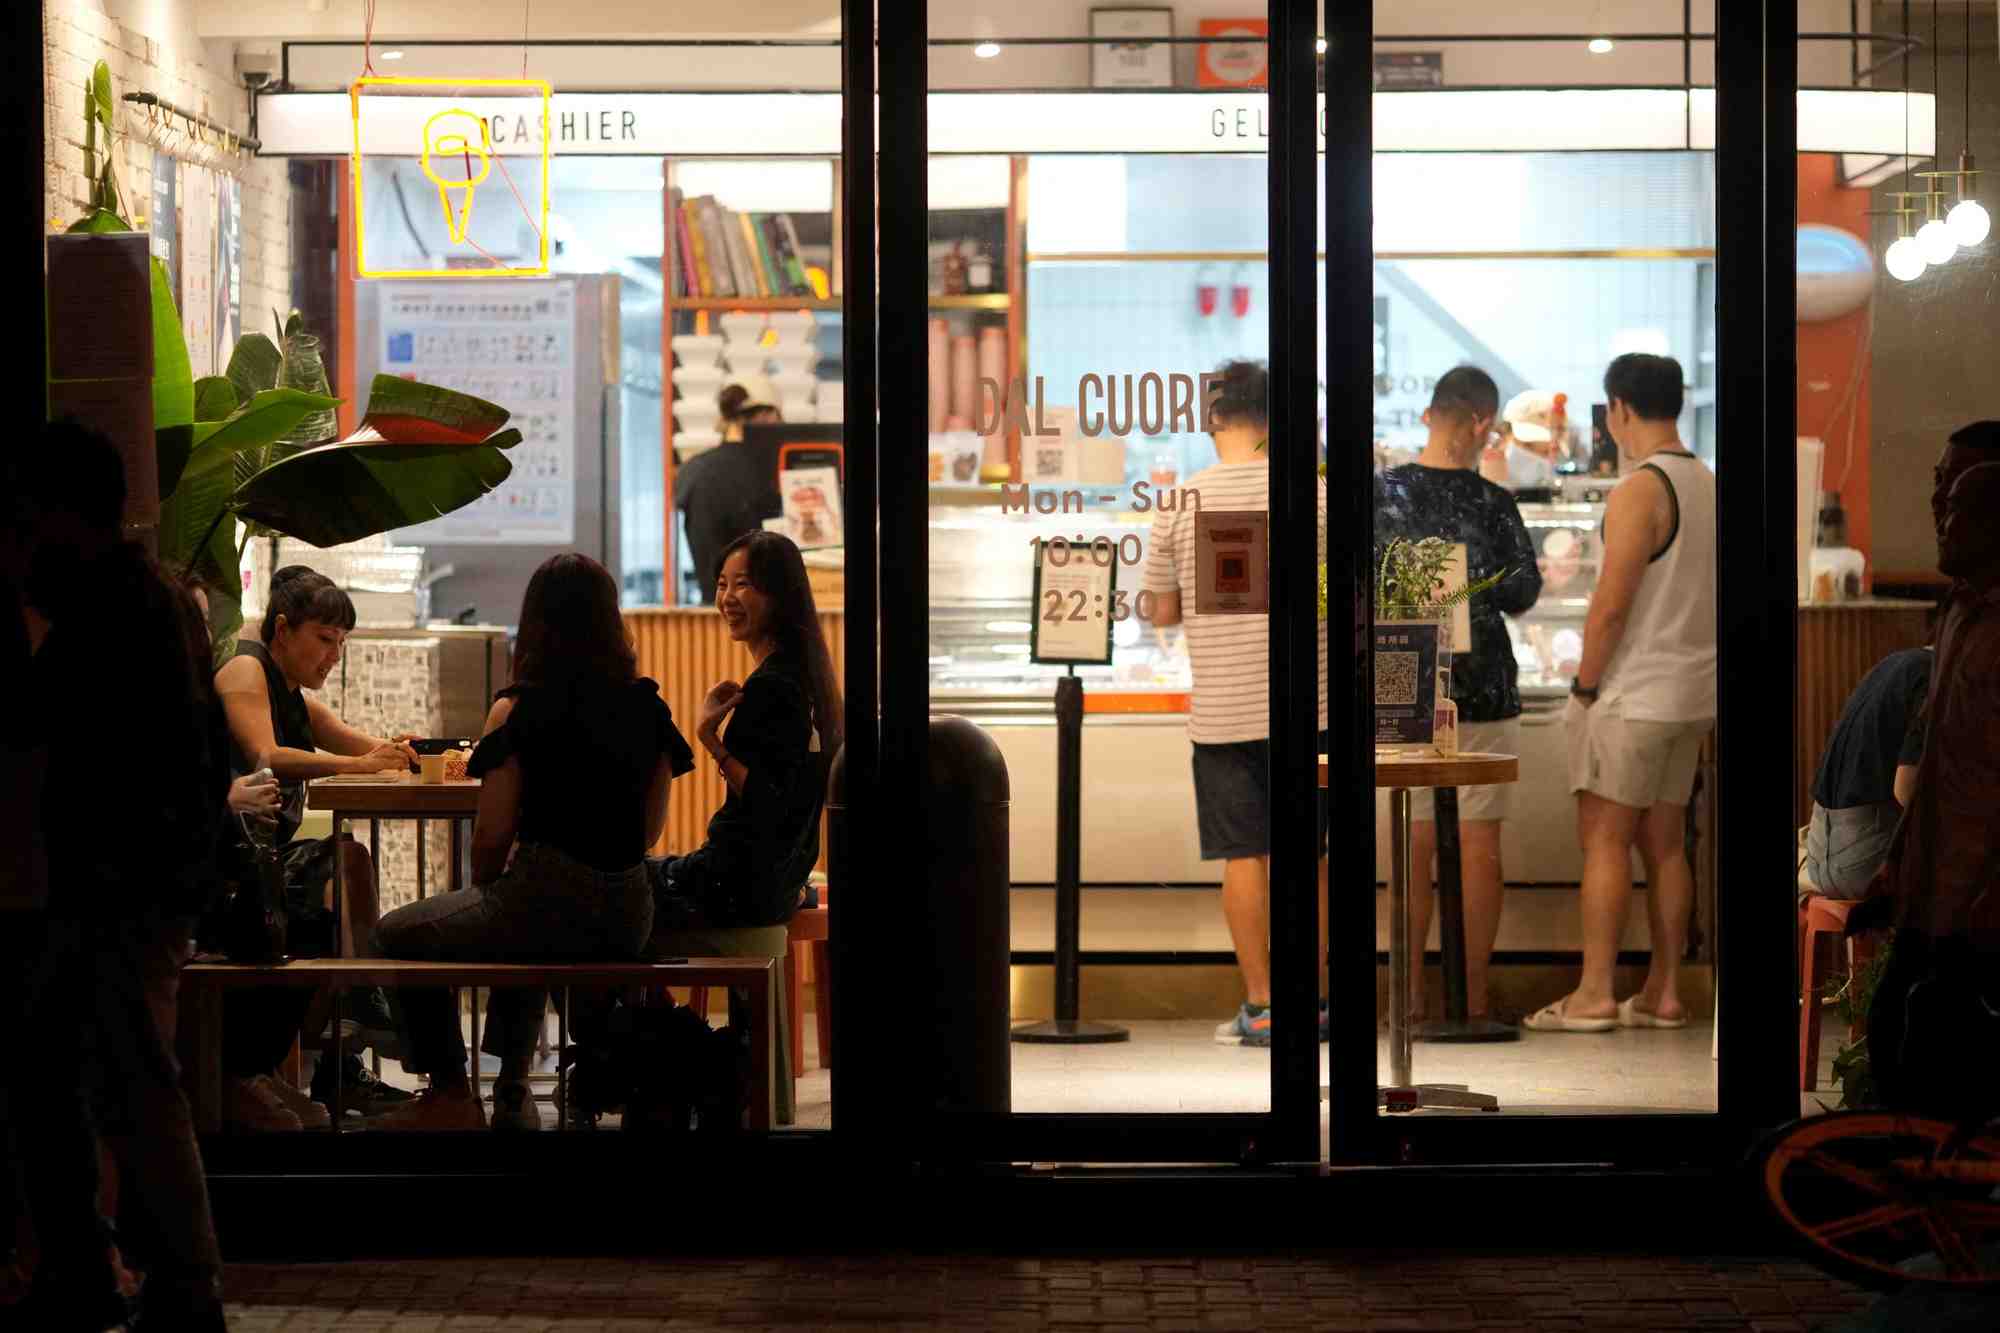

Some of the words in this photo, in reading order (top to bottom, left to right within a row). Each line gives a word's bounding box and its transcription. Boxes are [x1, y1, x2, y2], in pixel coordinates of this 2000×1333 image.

[491, 111, 636, 143] CASHIER
[1211, 108, 1327, 137] GEL
[976, 376, 1060, 436] DAL
[1079, 372, 1226, 437] CUORE
[1001, 483, 1083, 514] Mon
[1131, 480, 1202, 513] Sun
[1030, 534, 1142, 568] 10:00
[1043, 589, 1156, 622] 22:30
